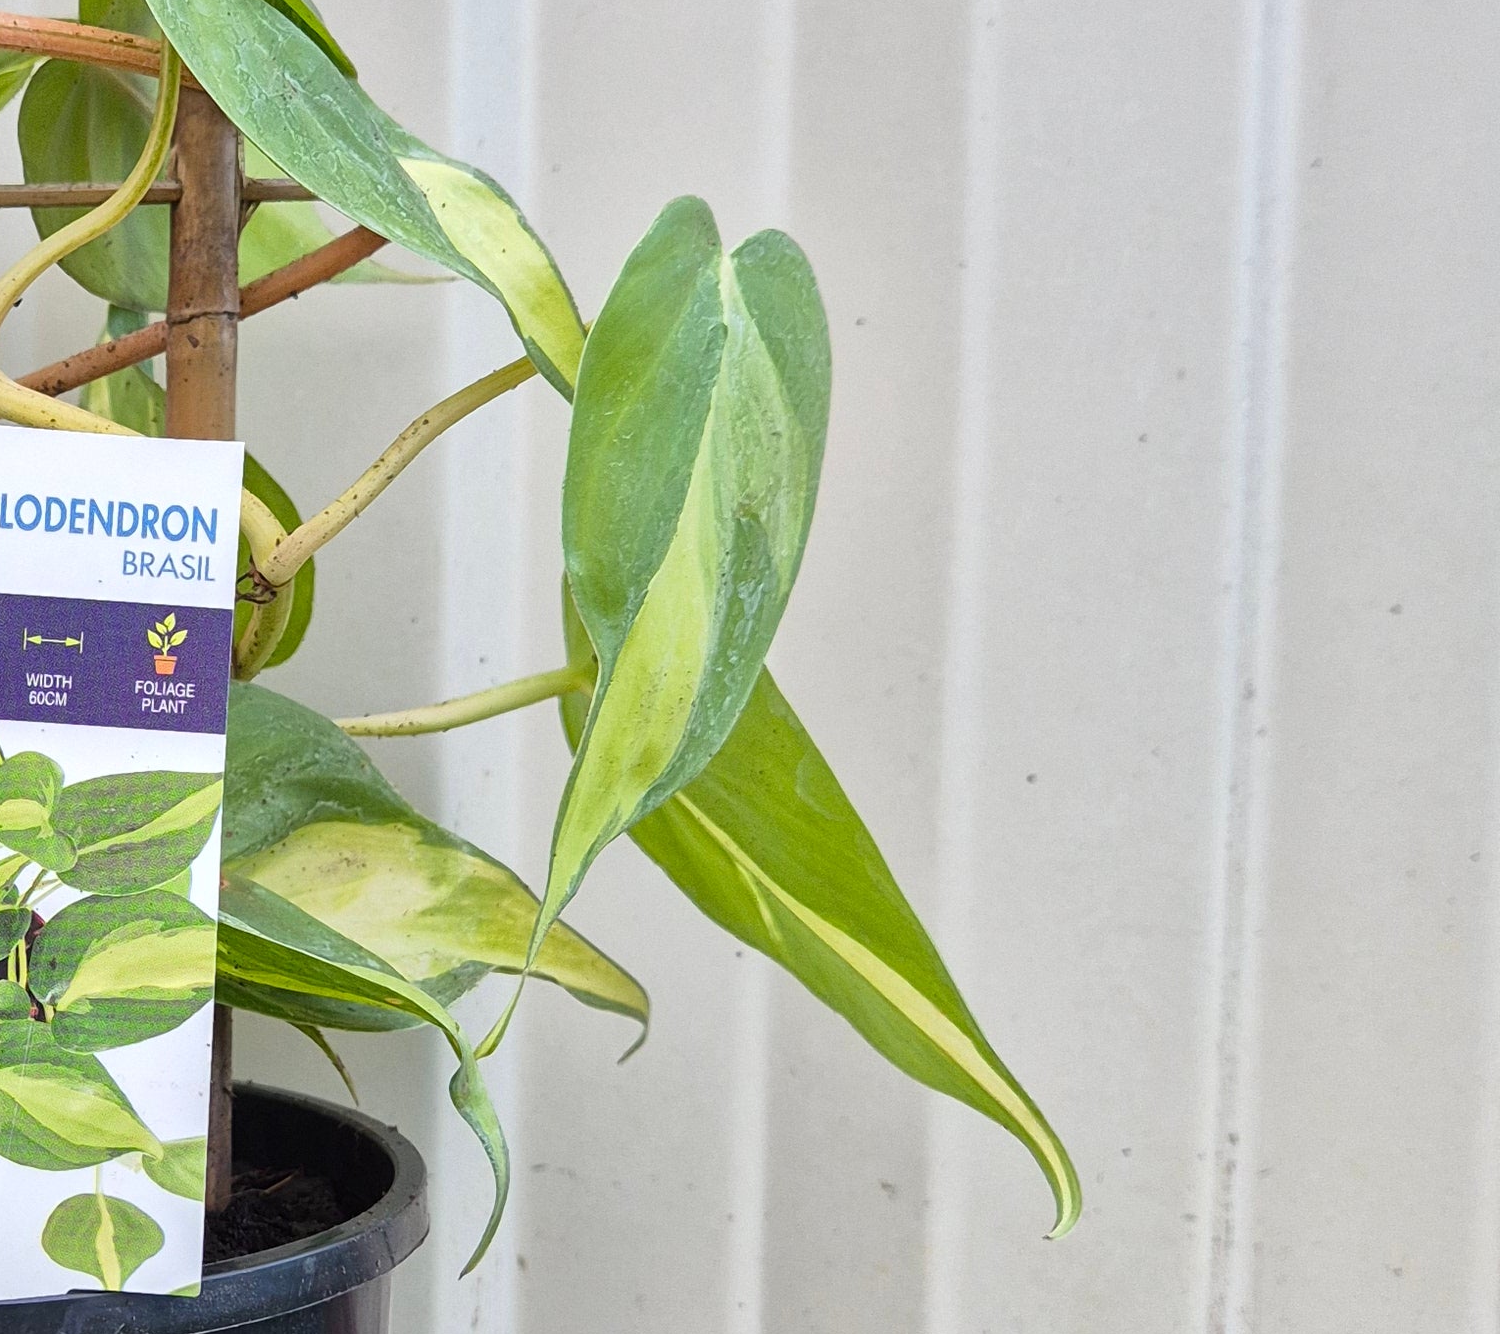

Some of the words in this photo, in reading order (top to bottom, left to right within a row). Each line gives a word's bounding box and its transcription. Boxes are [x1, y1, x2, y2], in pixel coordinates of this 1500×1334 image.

[122, 550, 216, 582] BRASIL
[25, 672, 73, 690] WIDTH
[134, 680, 196, 698] FOLIAGE
[28, 690, 68, 707] 60CM
[141, 697, 188, 715] PLANT
